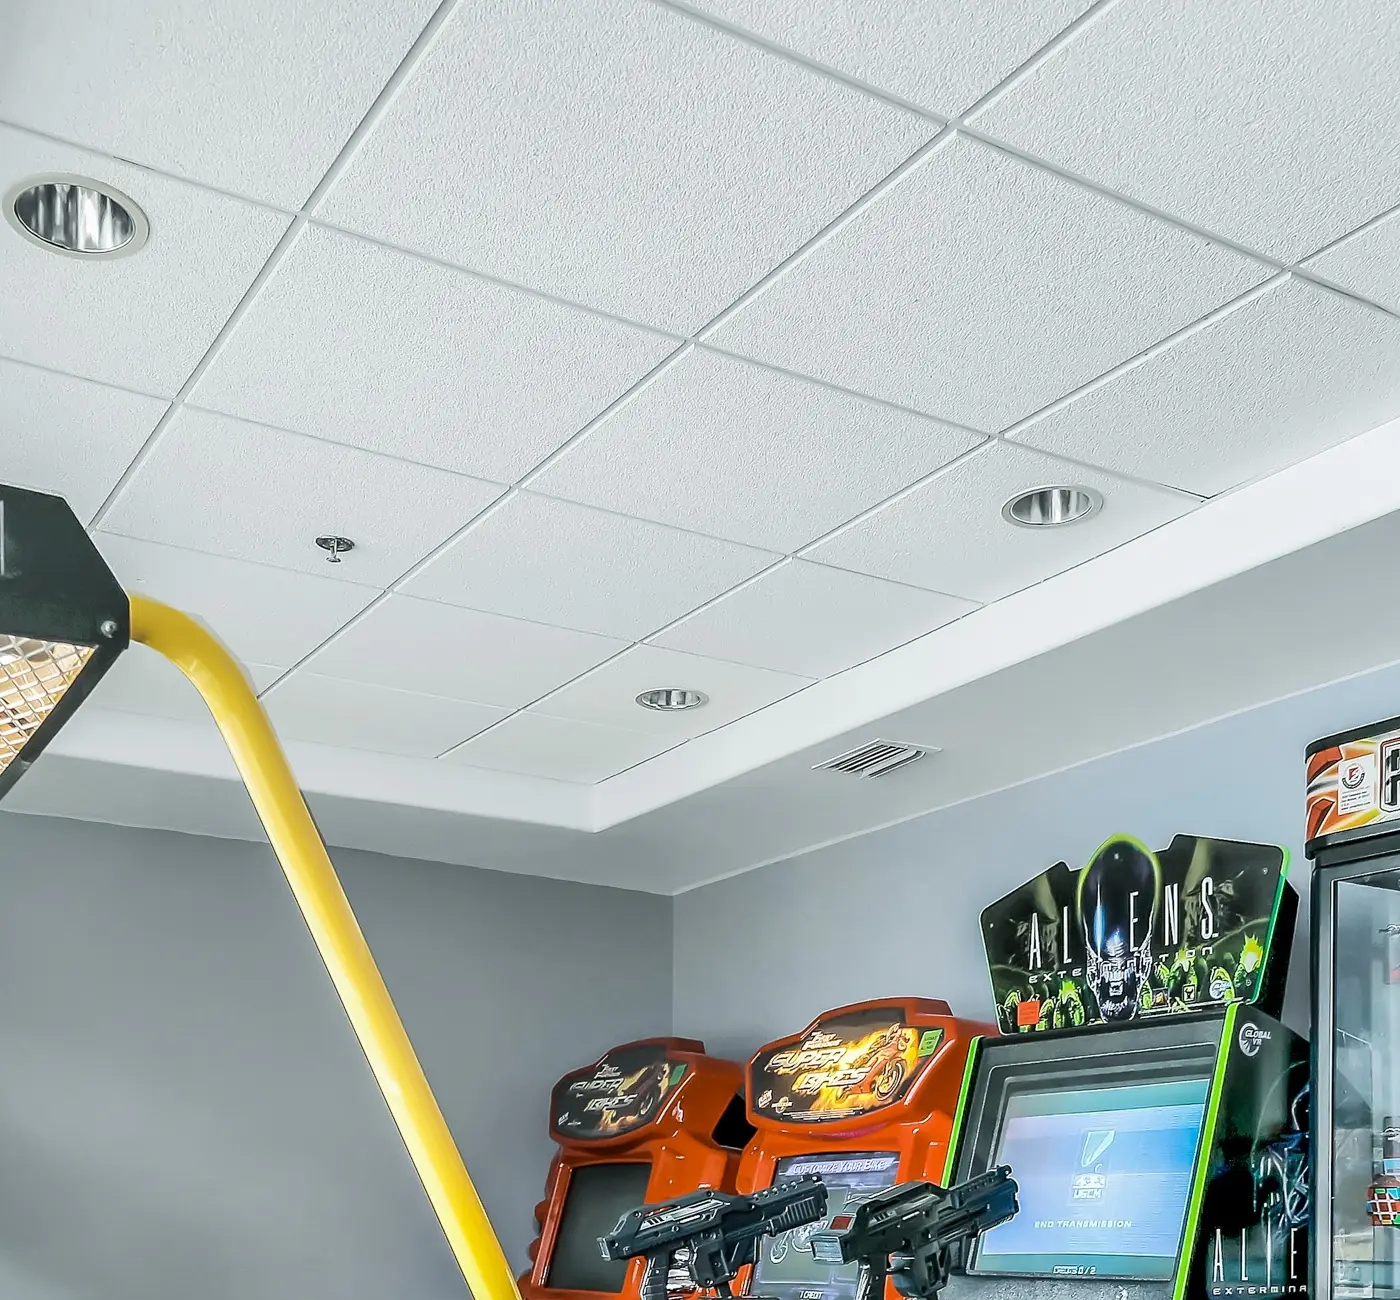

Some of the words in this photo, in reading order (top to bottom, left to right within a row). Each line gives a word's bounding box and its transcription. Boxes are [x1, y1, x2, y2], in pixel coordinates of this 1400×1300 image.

[1028, 876, 1214, 971] ALIENS
[1245, 1029, 1271, 1041] GLOBAL
[1252, 1038, 1263, 1047] VR
[766, 1047, 847, 1072] SUPER
[792, 1067, 872, 1095] BIKES
[1034, 1221, 1054, 1229] END
[1056, 1220, 1133, 1229] TRANSMISSION
